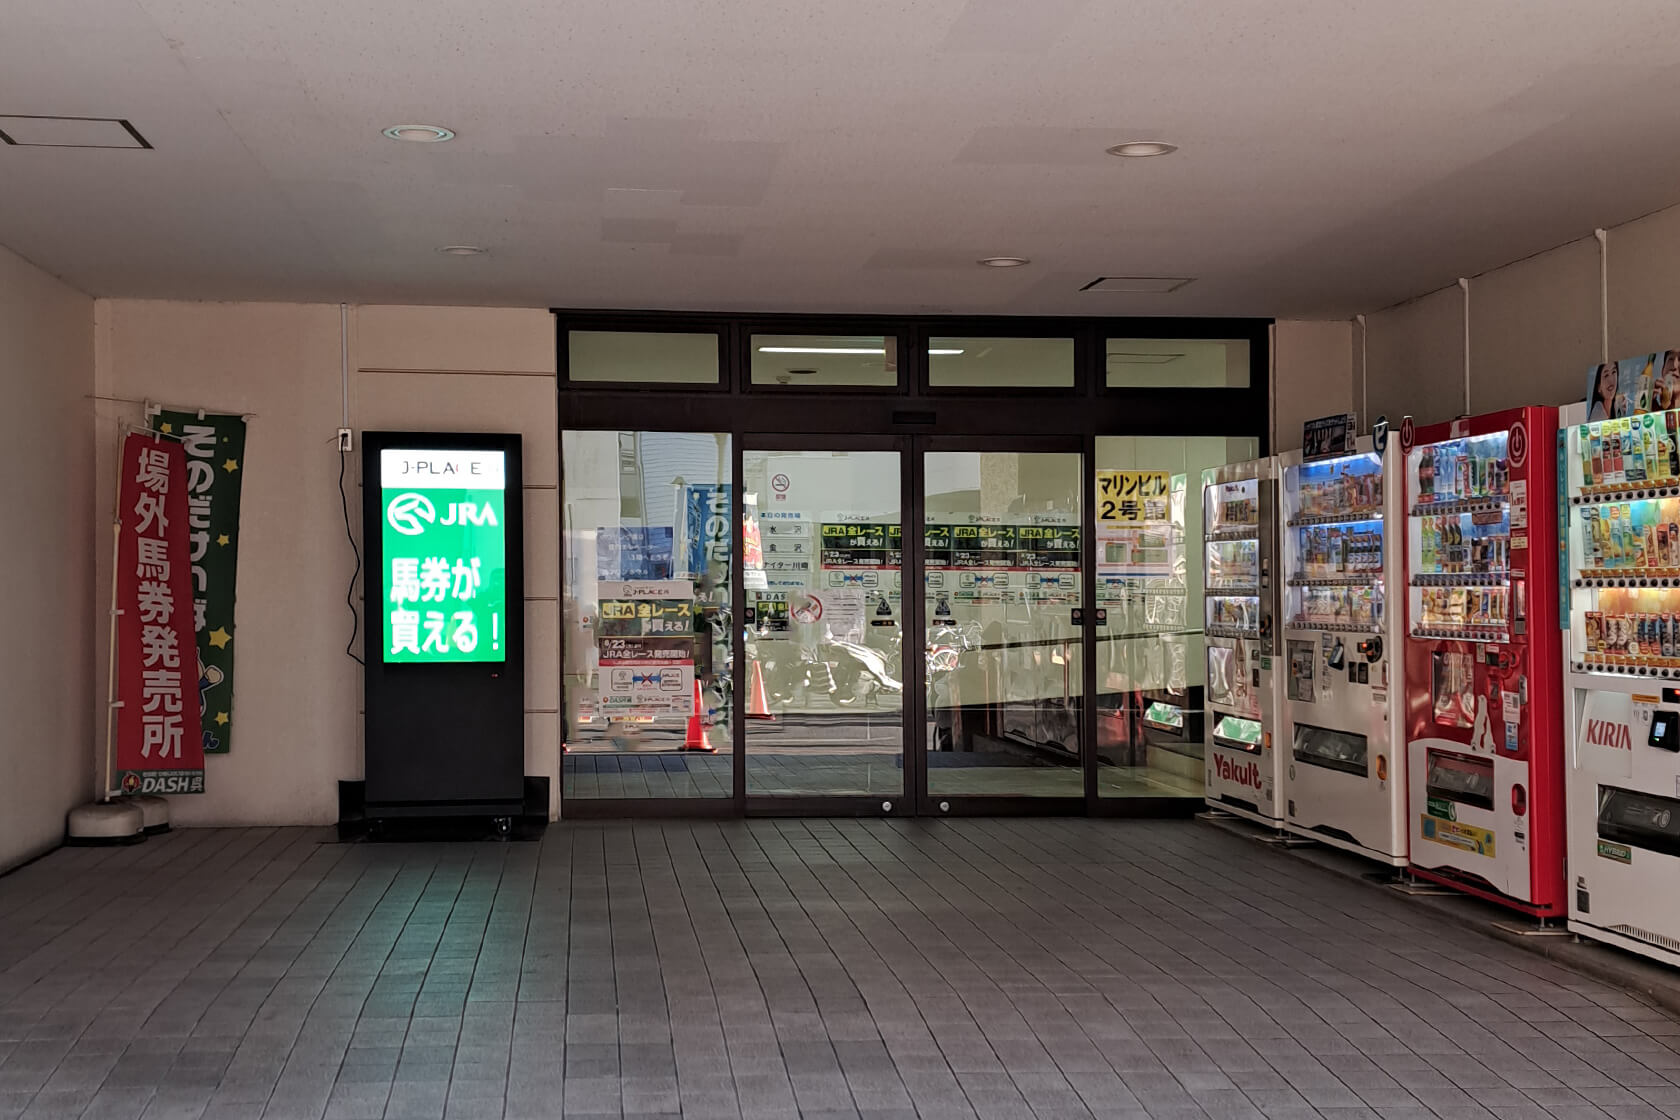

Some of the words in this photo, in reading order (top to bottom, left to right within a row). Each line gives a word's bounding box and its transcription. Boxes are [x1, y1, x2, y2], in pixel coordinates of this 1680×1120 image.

[1098, 474, 1167, 497] マリンビル
[440, 502, 499, 527] JRA
[824, 526, 845, 535] JRA
[847, 525, 884, 536] 全レース
[956, 527, 977, 537] JRA
[979, 527, 1015, 537] 全レース
[1020, 528, 1042, 537] JRA
[1044, 528, 1081, 538] 全レース
[390, 556, 481, 602] 馬券が
[133, 447, 184, 760] 場外馬券発売所
[603, 604, 634, 616] JRA
[637, 603, 691, 618] 全レース
[390, 610, 499, 655] 買える！
[1213, 752, 1263, 790] Yakult
